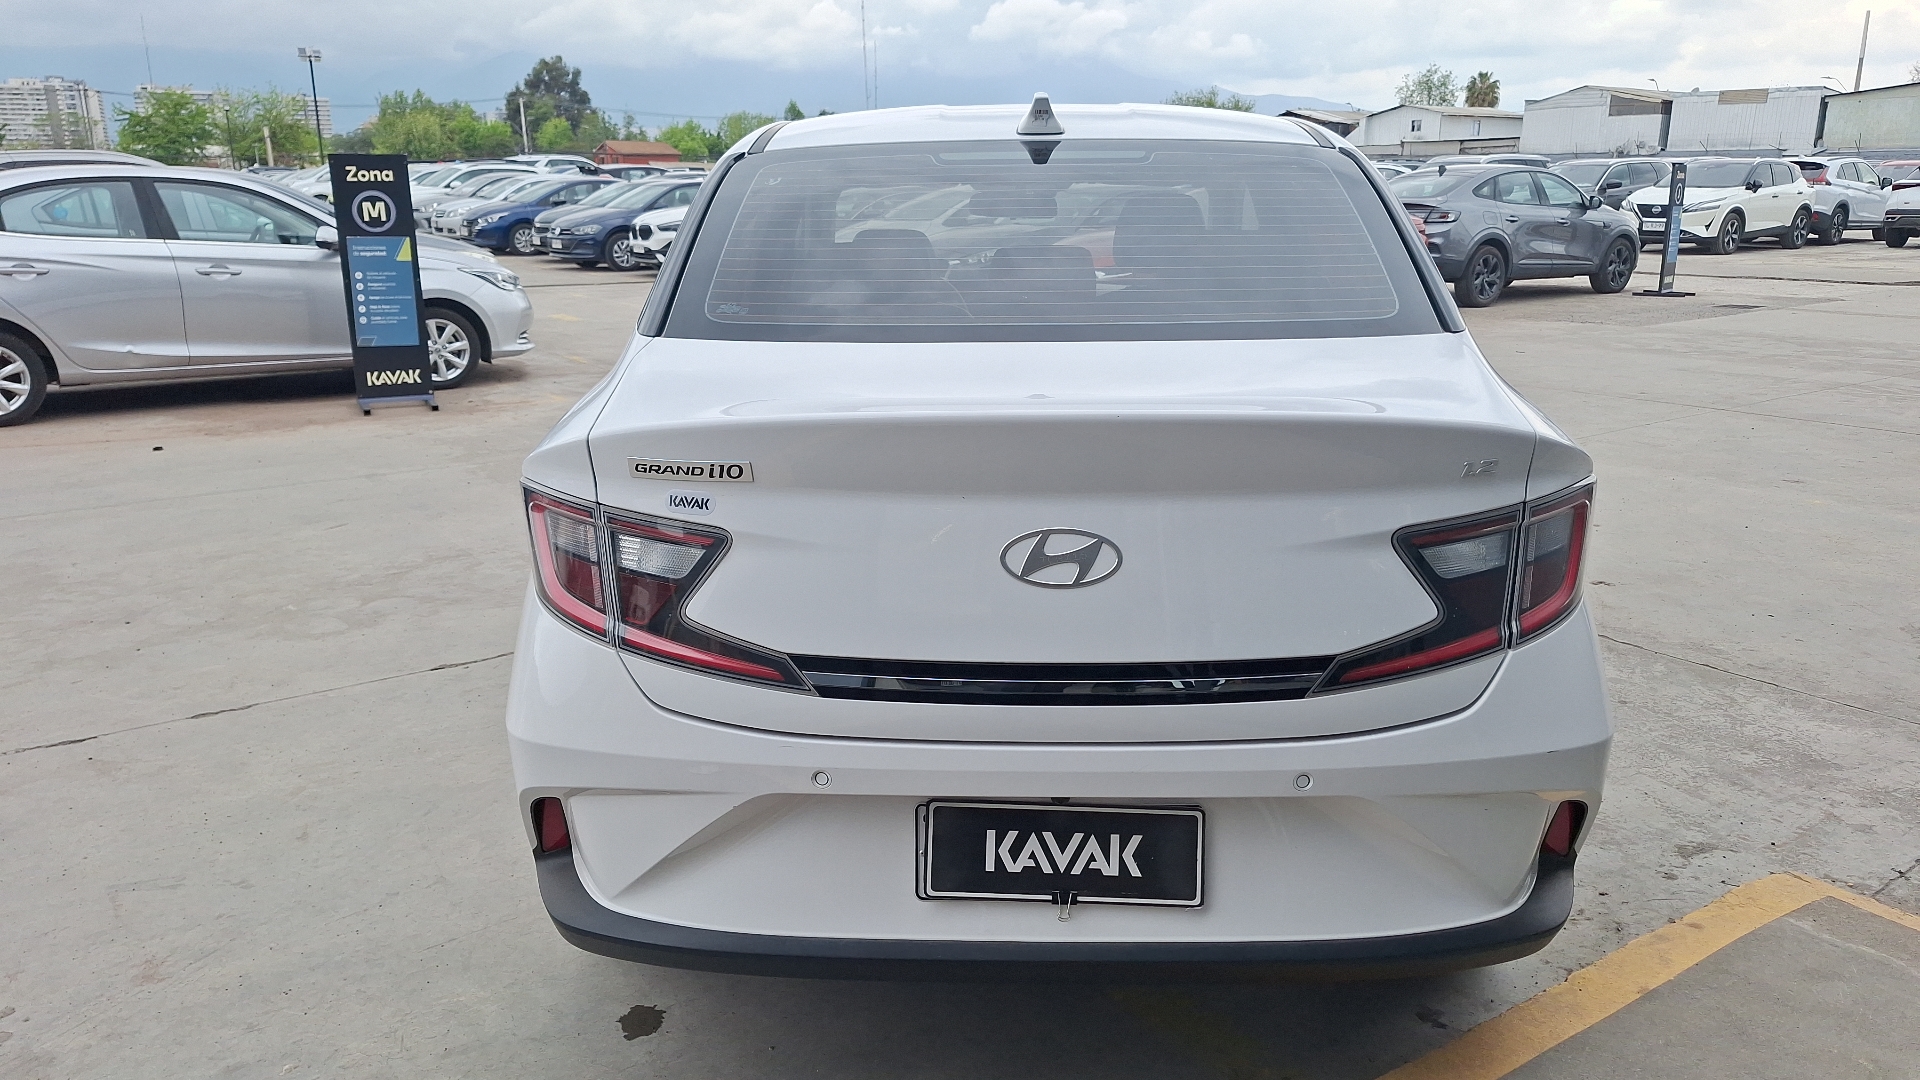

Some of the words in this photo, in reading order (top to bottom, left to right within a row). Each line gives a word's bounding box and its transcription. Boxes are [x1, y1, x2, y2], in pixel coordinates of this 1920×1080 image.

[345, 165, 394, 182] Zona
[362, 201, 387, 222] M
[366, 368, 422, 387] KAVAK
[634, 463, 705, 477] GRAND
[708, 463, 744, 479] i10
[669, 494, 711, 511] KAVAK
[985, 829, 1143, 878] KAVAK
